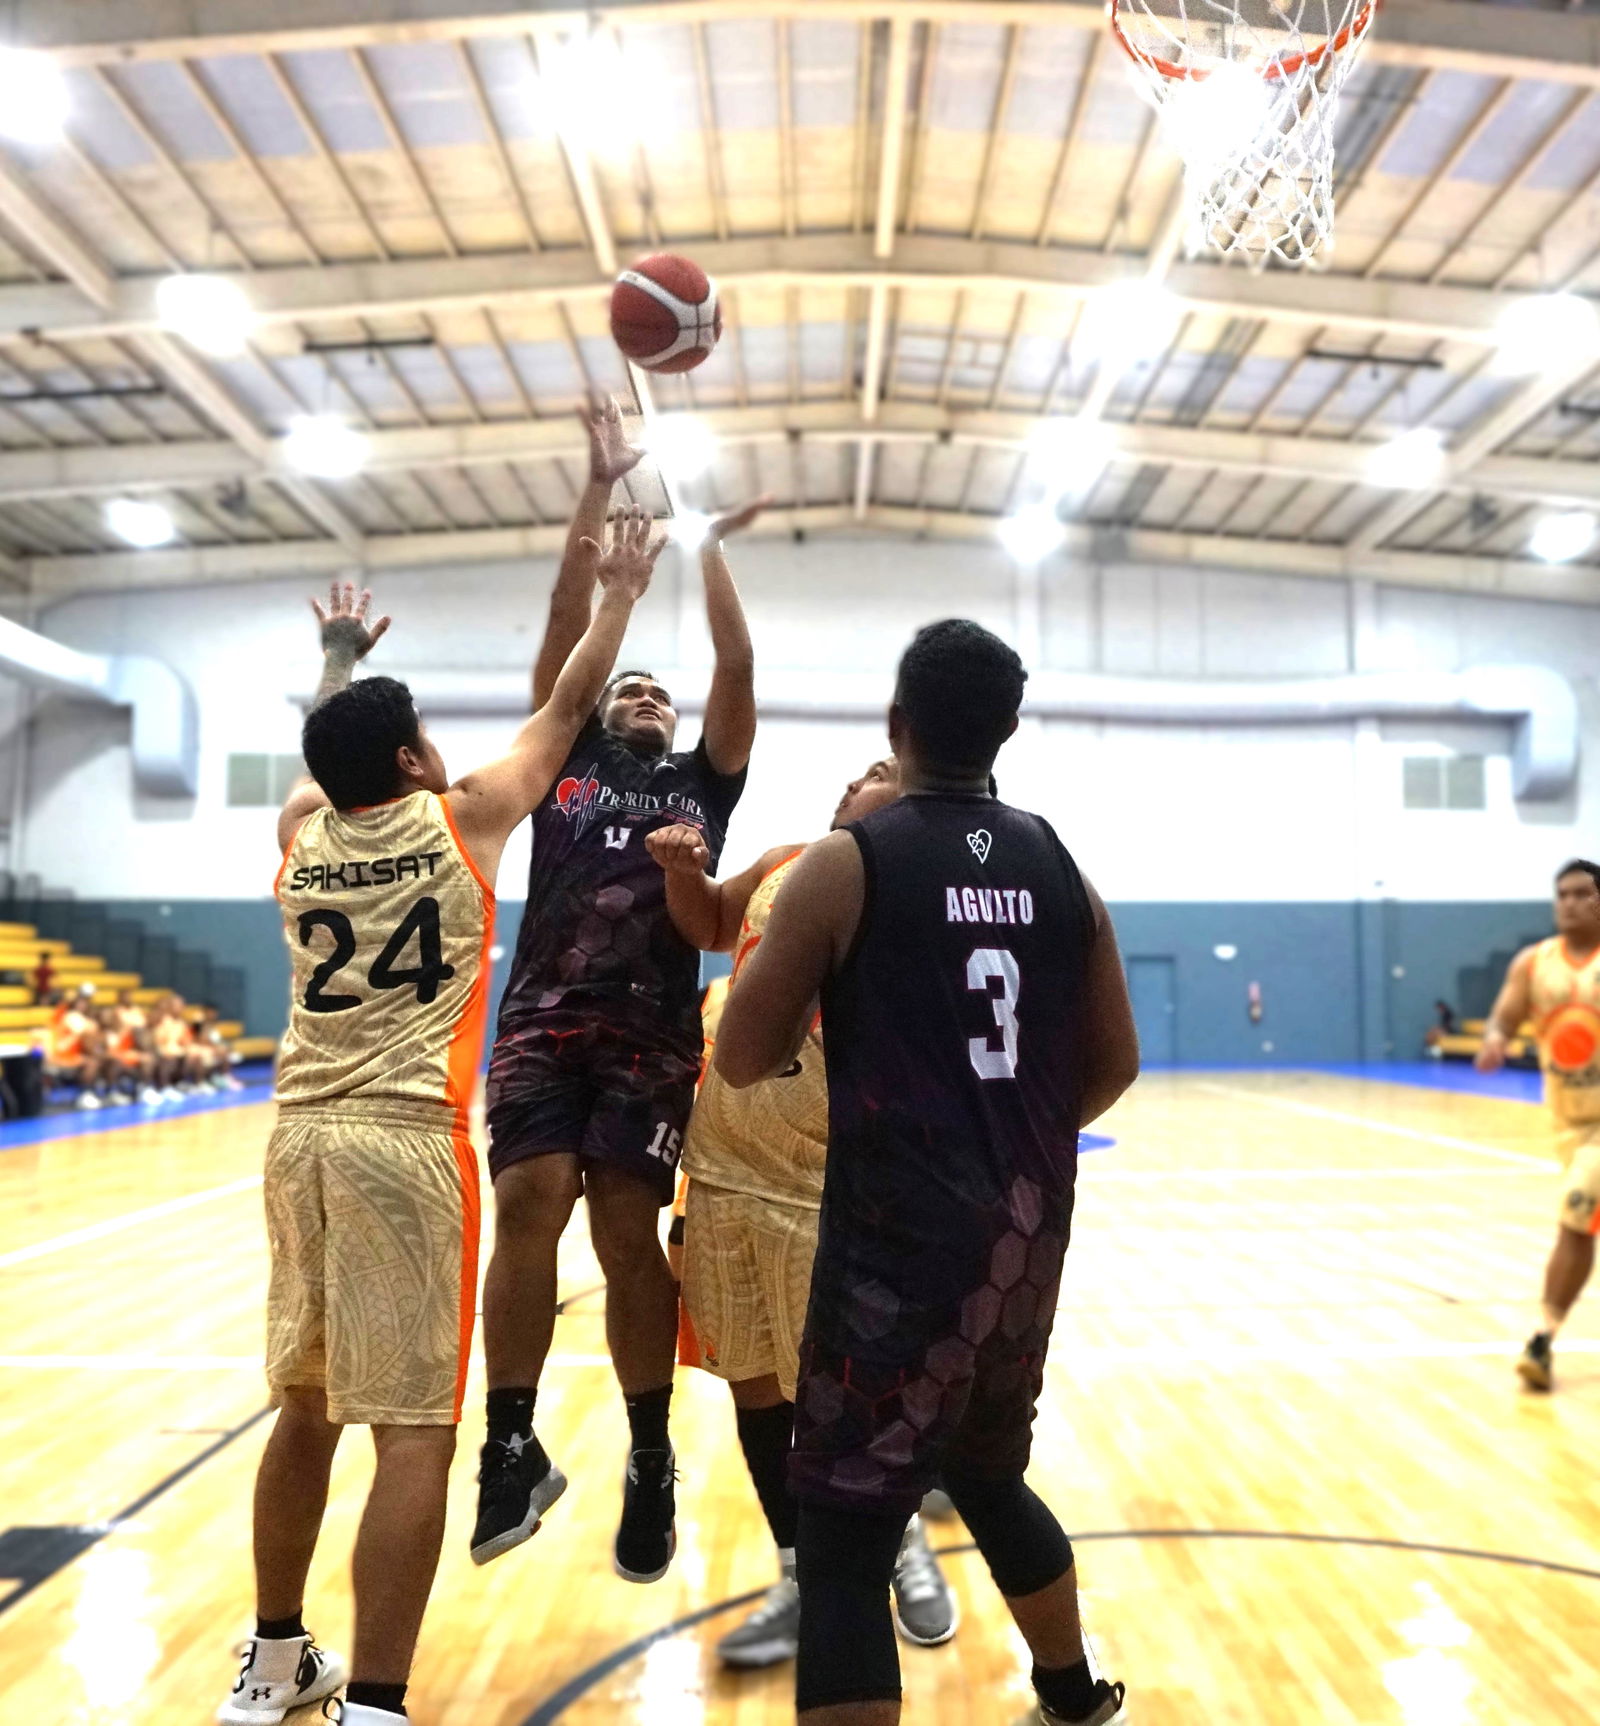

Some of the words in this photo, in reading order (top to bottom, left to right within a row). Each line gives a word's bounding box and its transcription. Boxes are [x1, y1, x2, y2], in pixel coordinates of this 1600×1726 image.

[290, 851, 442, 891] SAKISAT
[945, 887, 1034, 924] AGULTO
[297, 896, 455, 1013] 24
[966, 948, 1020, 1080] 3
[645, 1121, 681, 1167] 15
